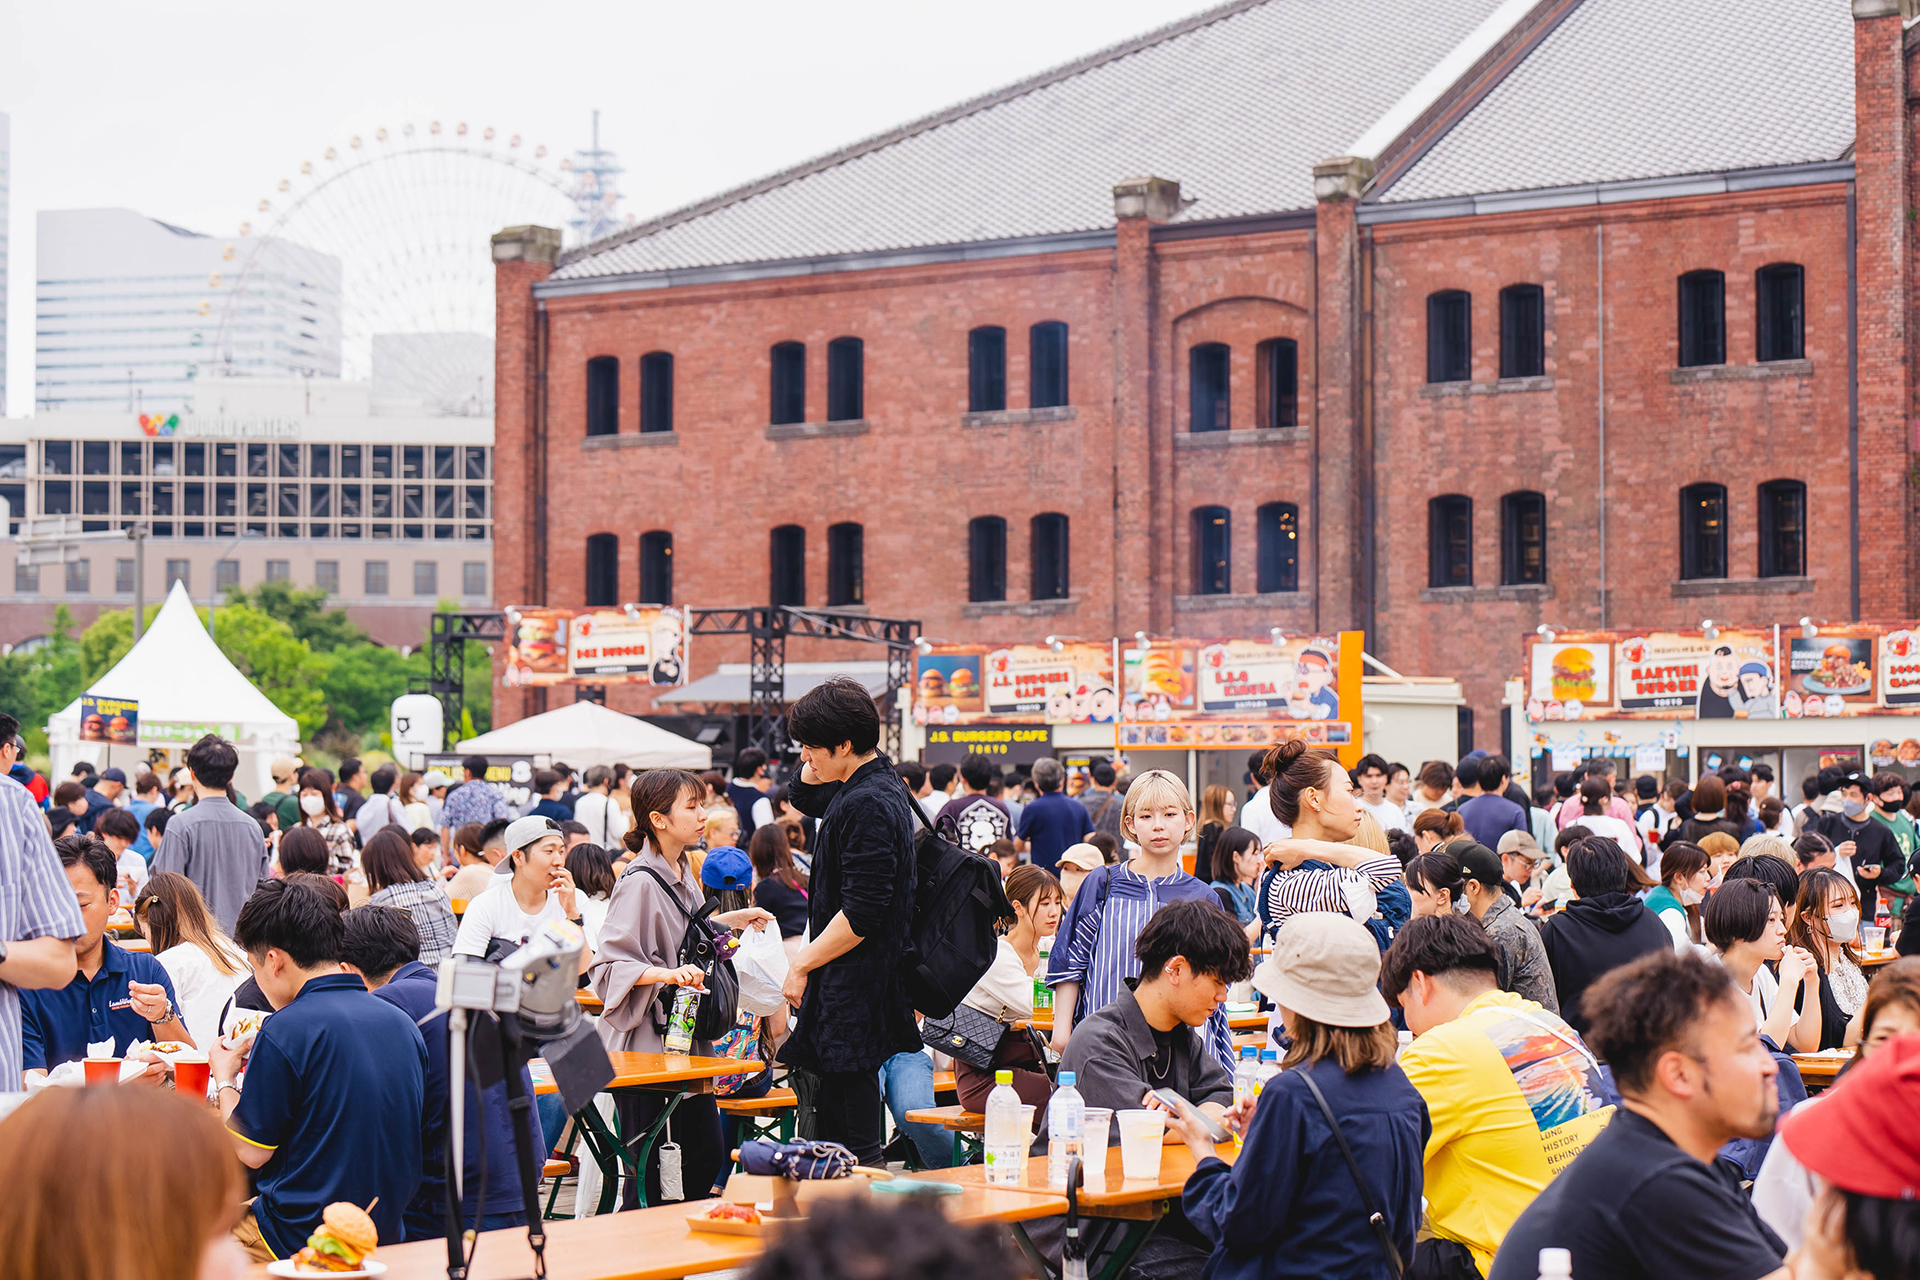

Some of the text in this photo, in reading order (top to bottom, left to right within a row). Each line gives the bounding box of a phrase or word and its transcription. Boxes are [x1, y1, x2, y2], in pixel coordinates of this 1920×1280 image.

[1015, 672, 1069, 686] BURGERS
[1631, 664, 1698, 680] MARTINI
[1015, 687, 1046, 699] CAFE
[1224, 683, 1277, 697] KIMURA
[1636, 679, 1697, 695] BURGER
[929, 730, 1048, 743] J.S. BURGERS CAFE
[968, 744, 1008, 755] TOKYO
[1540, 1127, 1563, 1141] LONG
[1543, 1133, 1579, 1153] HISTORY
[1547, 1146, 1581, 1165] BEHIND
